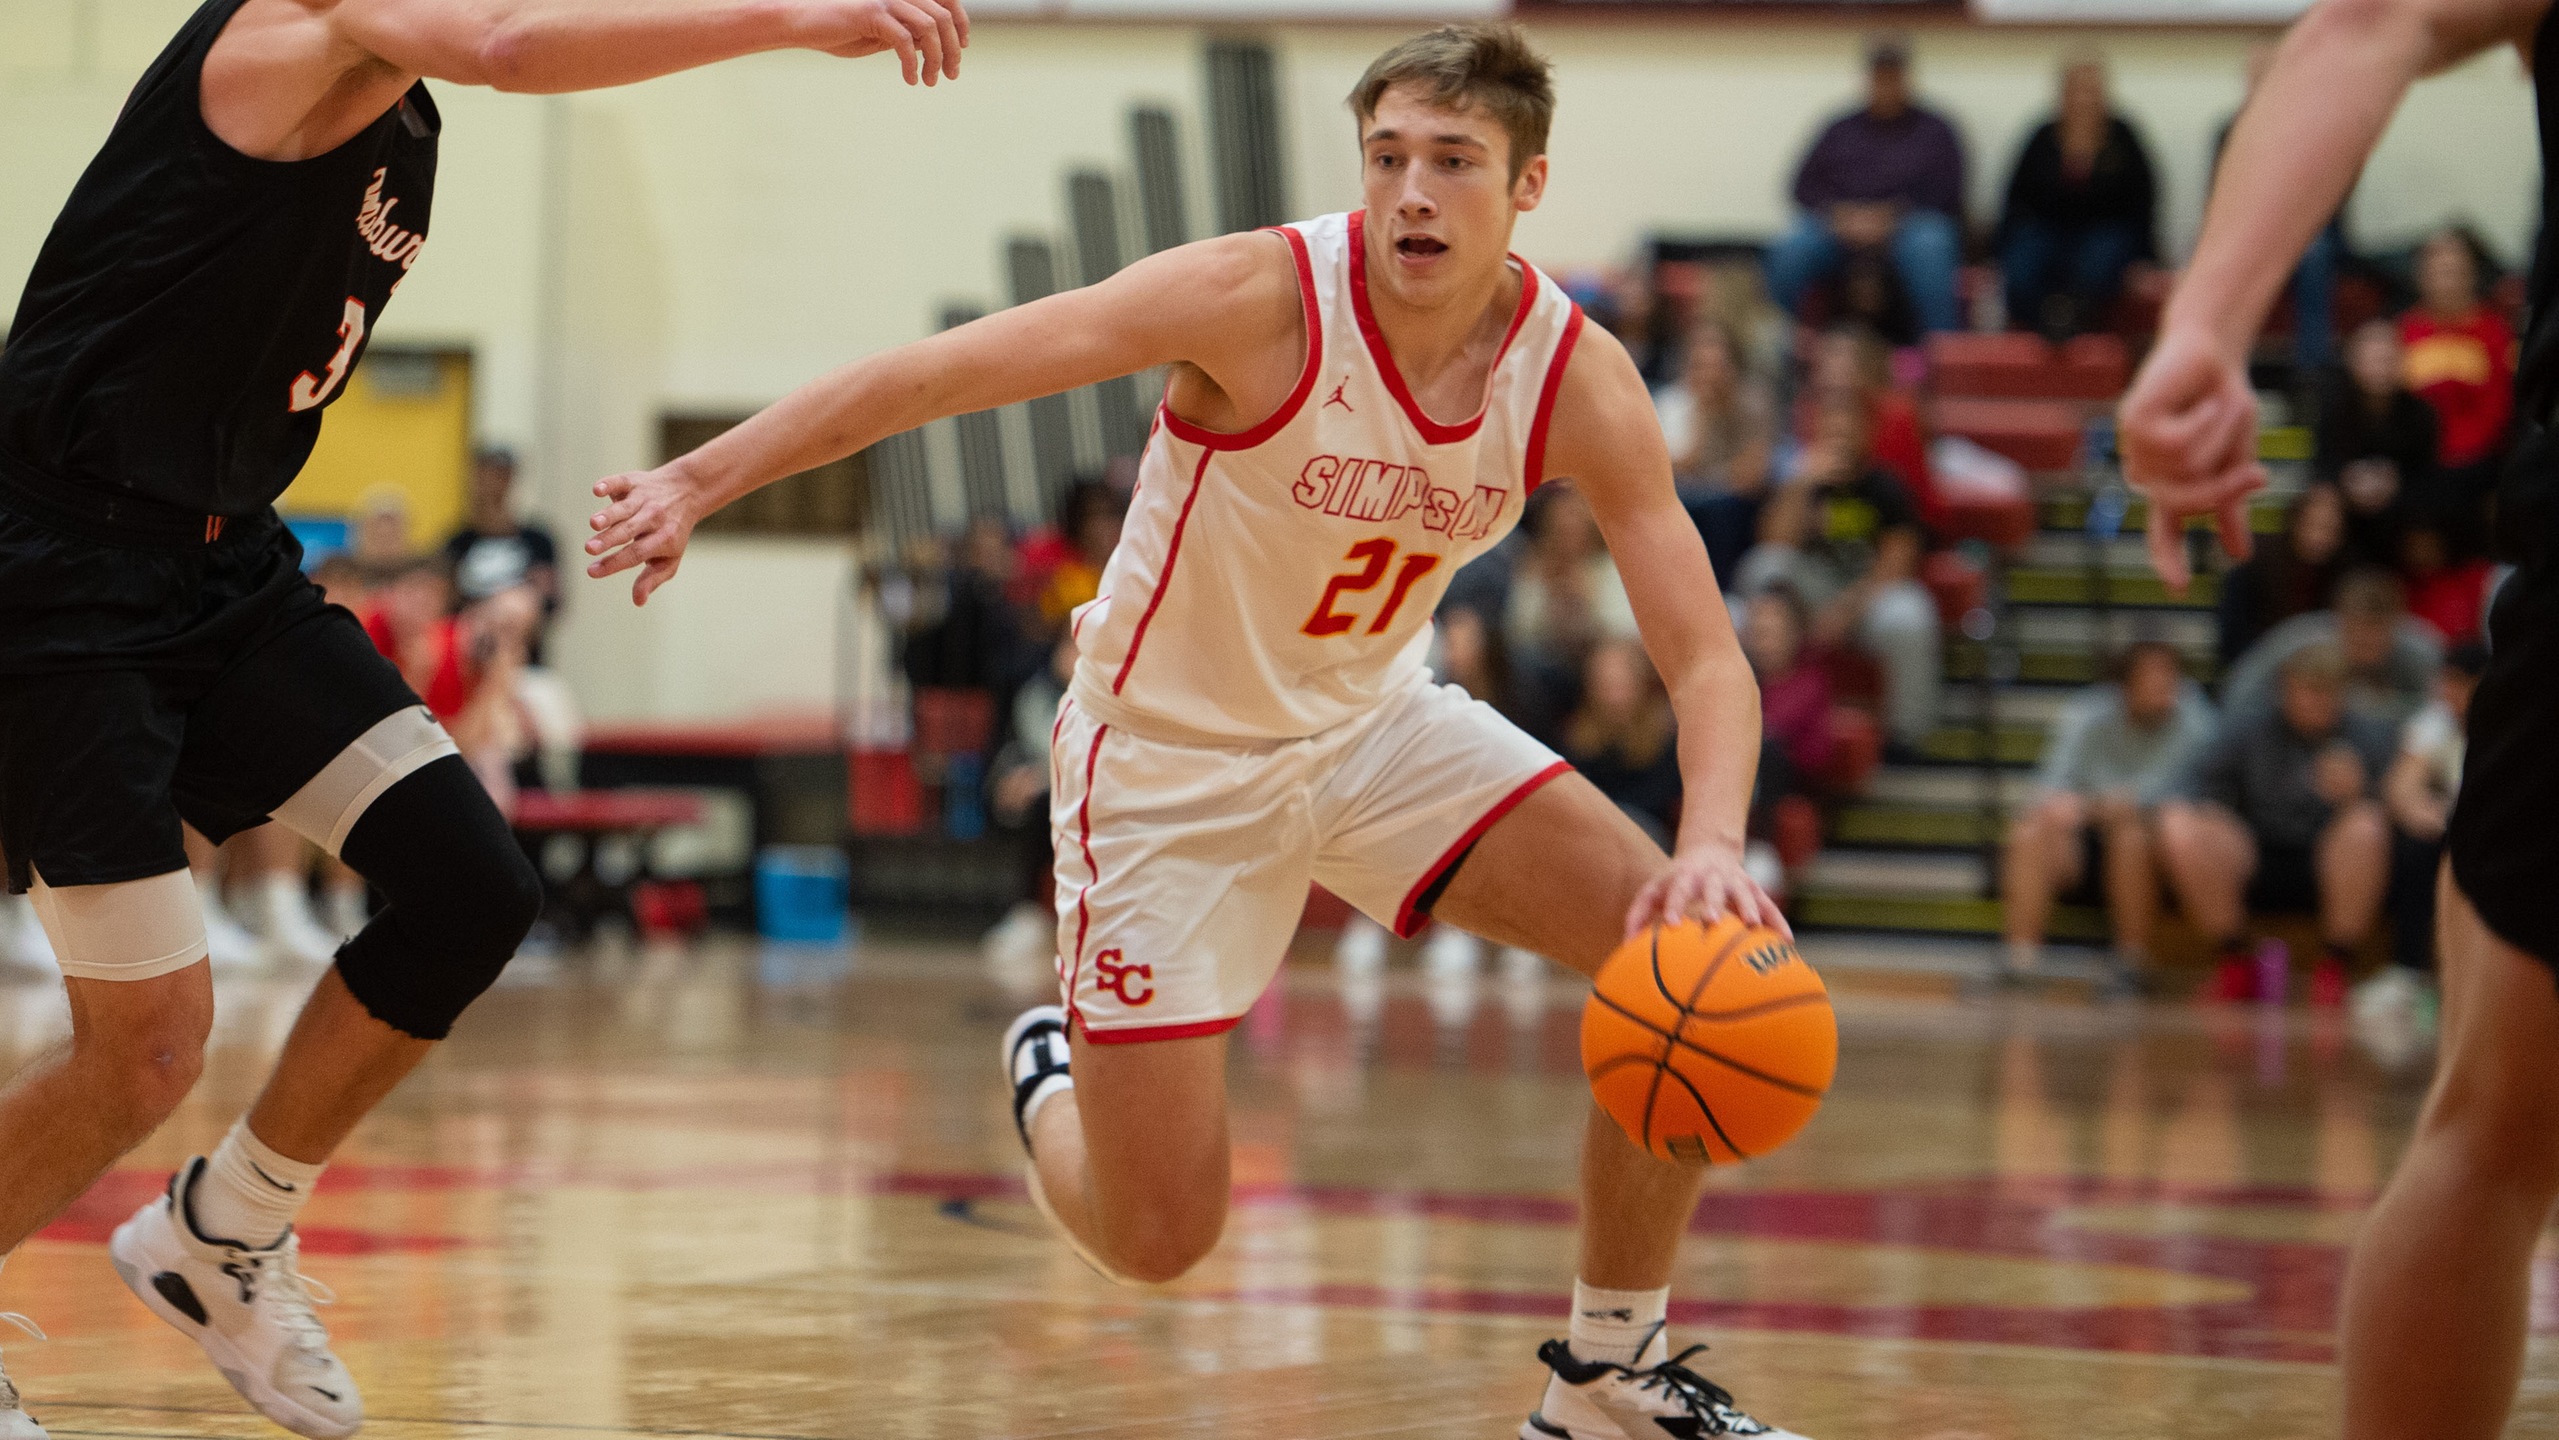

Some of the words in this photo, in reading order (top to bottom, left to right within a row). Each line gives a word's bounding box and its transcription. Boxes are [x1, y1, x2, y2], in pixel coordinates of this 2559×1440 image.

[288, 295, 366, 413] 3
[1300, 537, 1441, 638] 21
[1095, 948, 1156, 1008] SC
